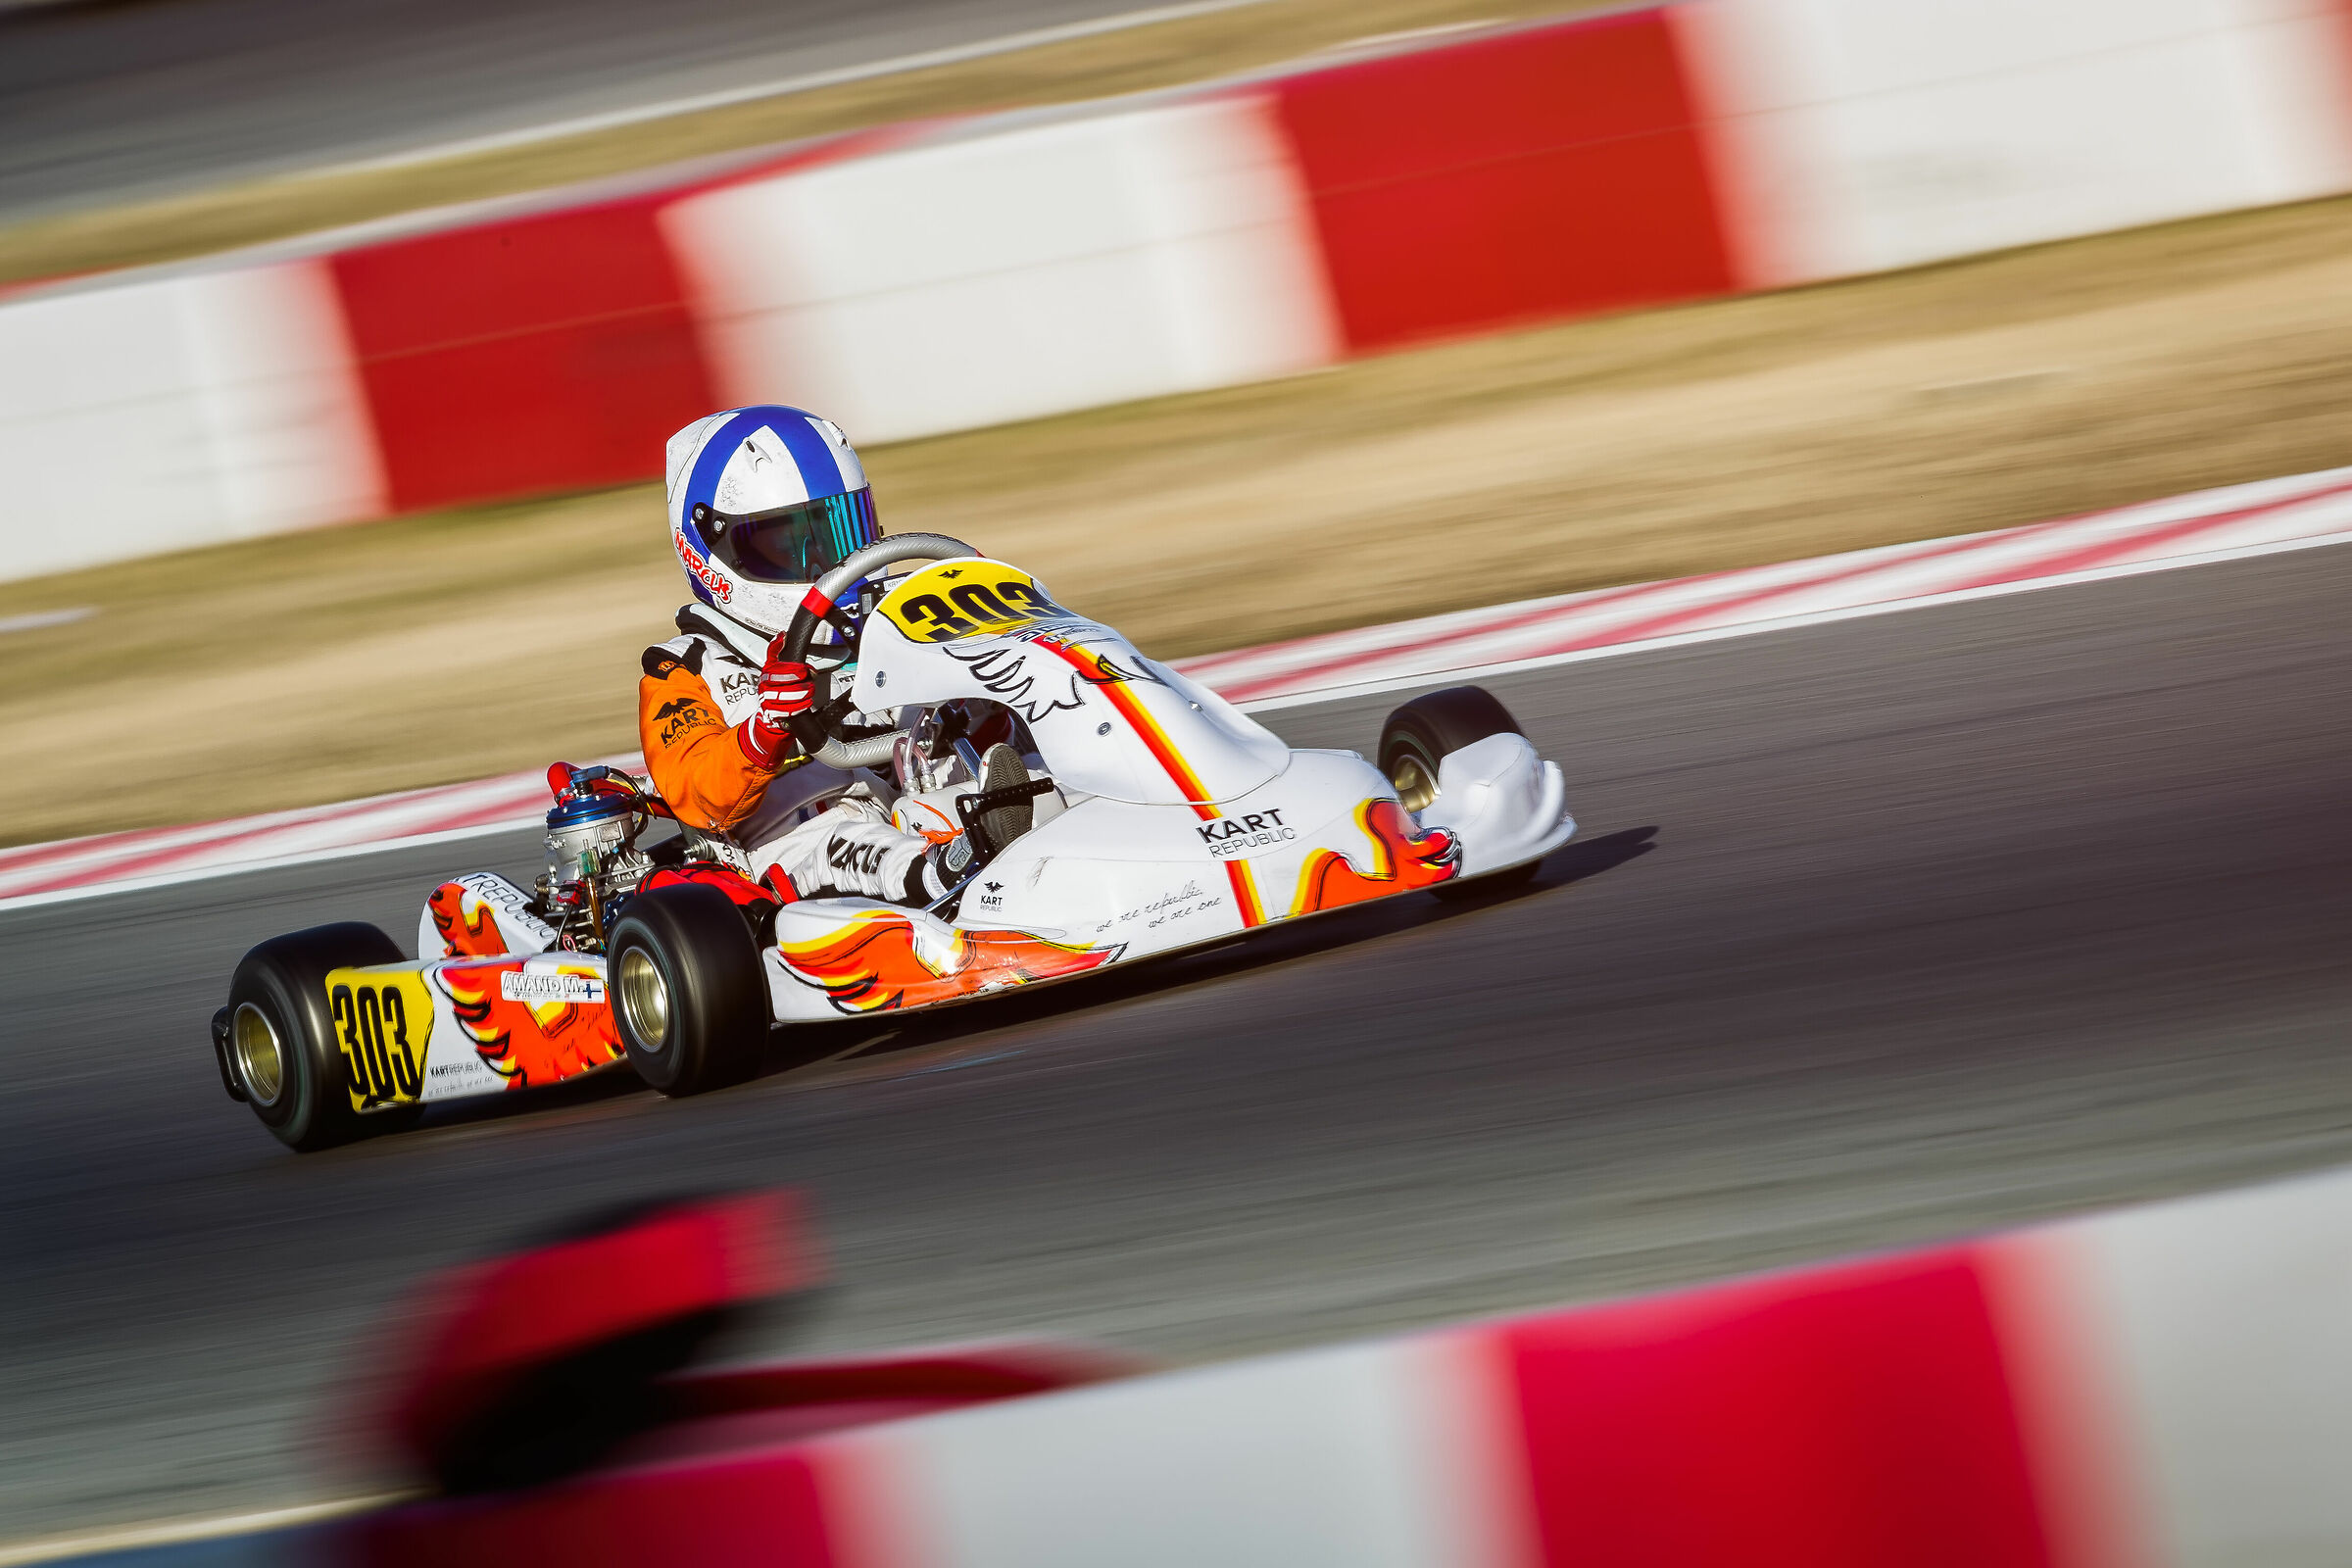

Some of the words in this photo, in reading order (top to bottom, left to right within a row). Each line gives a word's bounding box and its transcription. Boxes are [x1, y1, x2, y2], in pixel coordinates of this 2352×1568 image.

[674, 528, 733, 604] MARCUS
[900, 581, 1076, 642] 303
[719, 672, 760, 694] KAR
[724, 687, 758, 706] REPU
[1195, 808, 1284, 844] KART
[1208, 827, 1296, 858] REPUBLIC
[980, 895, 1003, 906] KART
[331, 984, 421, 1098] 303
